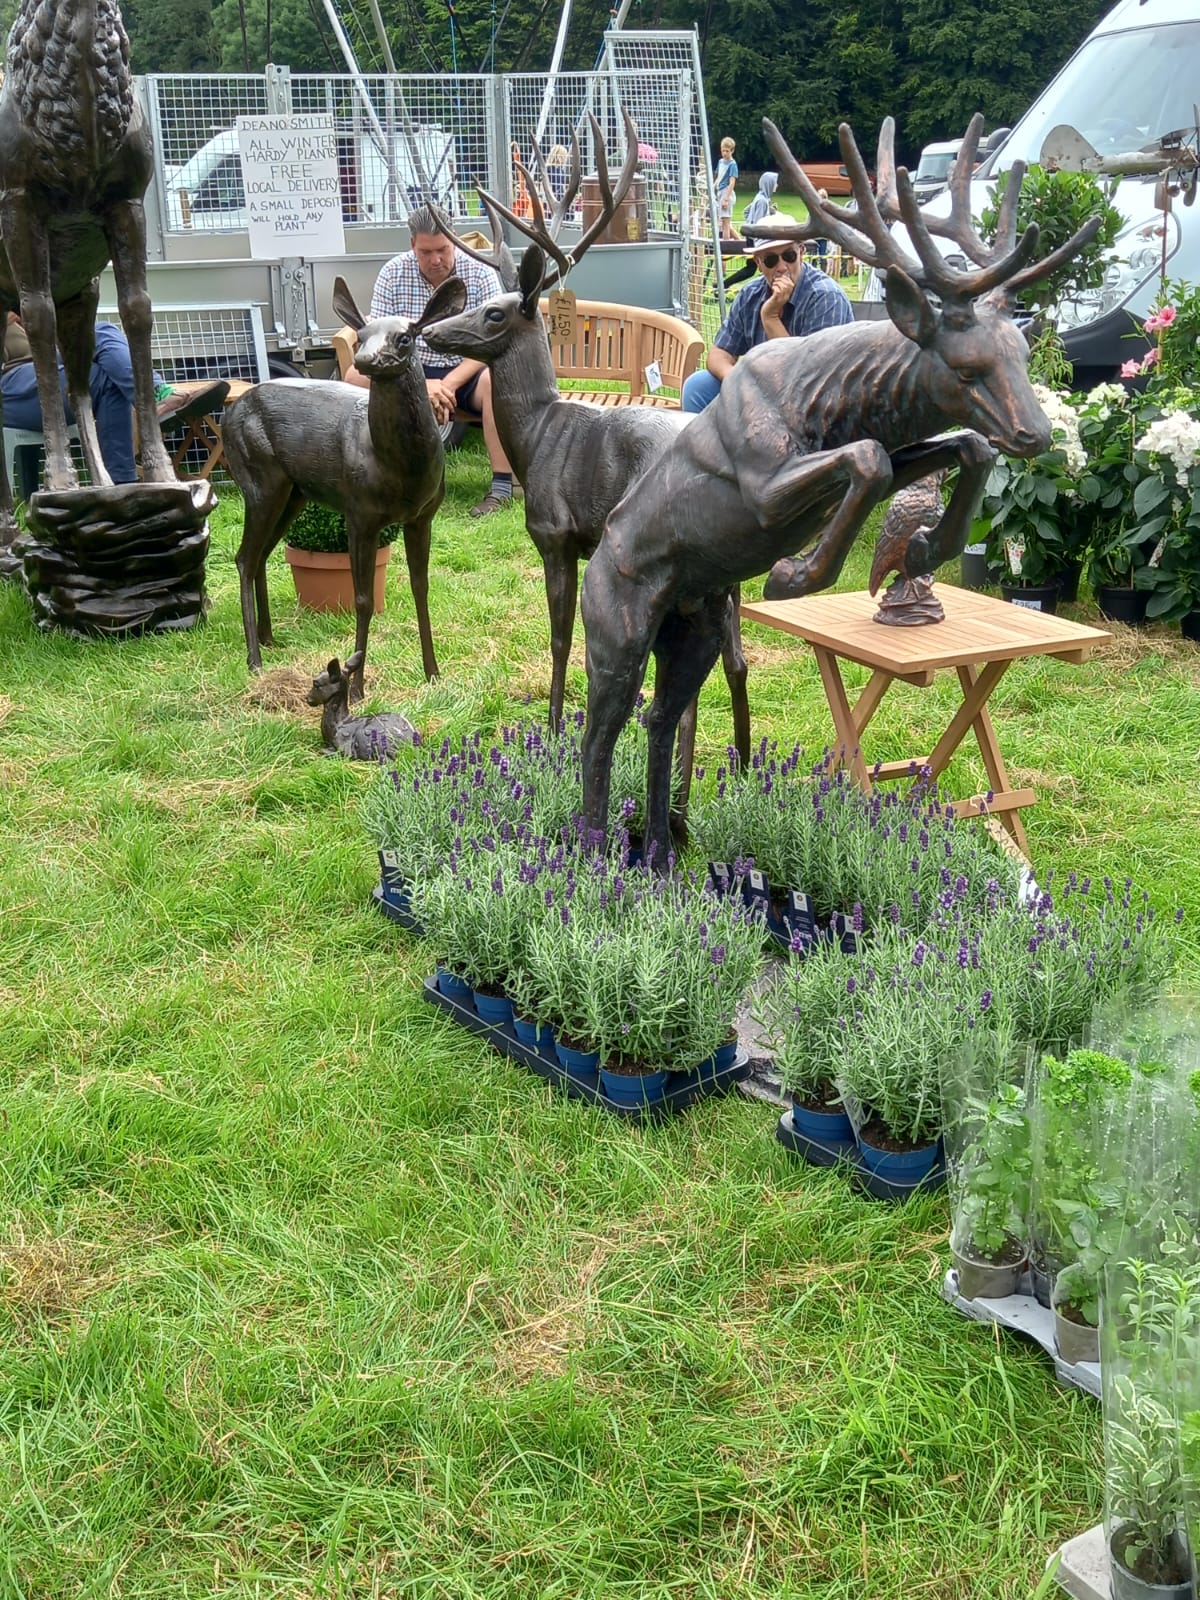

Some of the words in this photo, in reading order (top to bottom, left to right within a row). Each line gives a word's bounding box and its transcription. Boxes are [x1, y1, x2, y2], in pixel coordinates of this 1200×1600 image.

[242, 119, 287, 131] DEANO
[290, 116, 333, 130] SMITH
[250, 139, 273, 151] ALL
[281, 134, 336, 149] WINTER
[245, 150, 288, 163] HARDY
[297, 148, 337, 160] PLANTS
[270, 164, 313, 179] FREE
[247, 181, 282, 194] LOCAL
[288, 178, 339, 193] DELIVERY
[250, 201, 257, 211] A
[261, 200, 294, 211] SMALL
[301, 197, 340, 209] DEPOSIT
[278, 214, 300, 222] HOLD
[306, 212, 324, 223] ANY
[275, 221, 307, 232] PLANT
